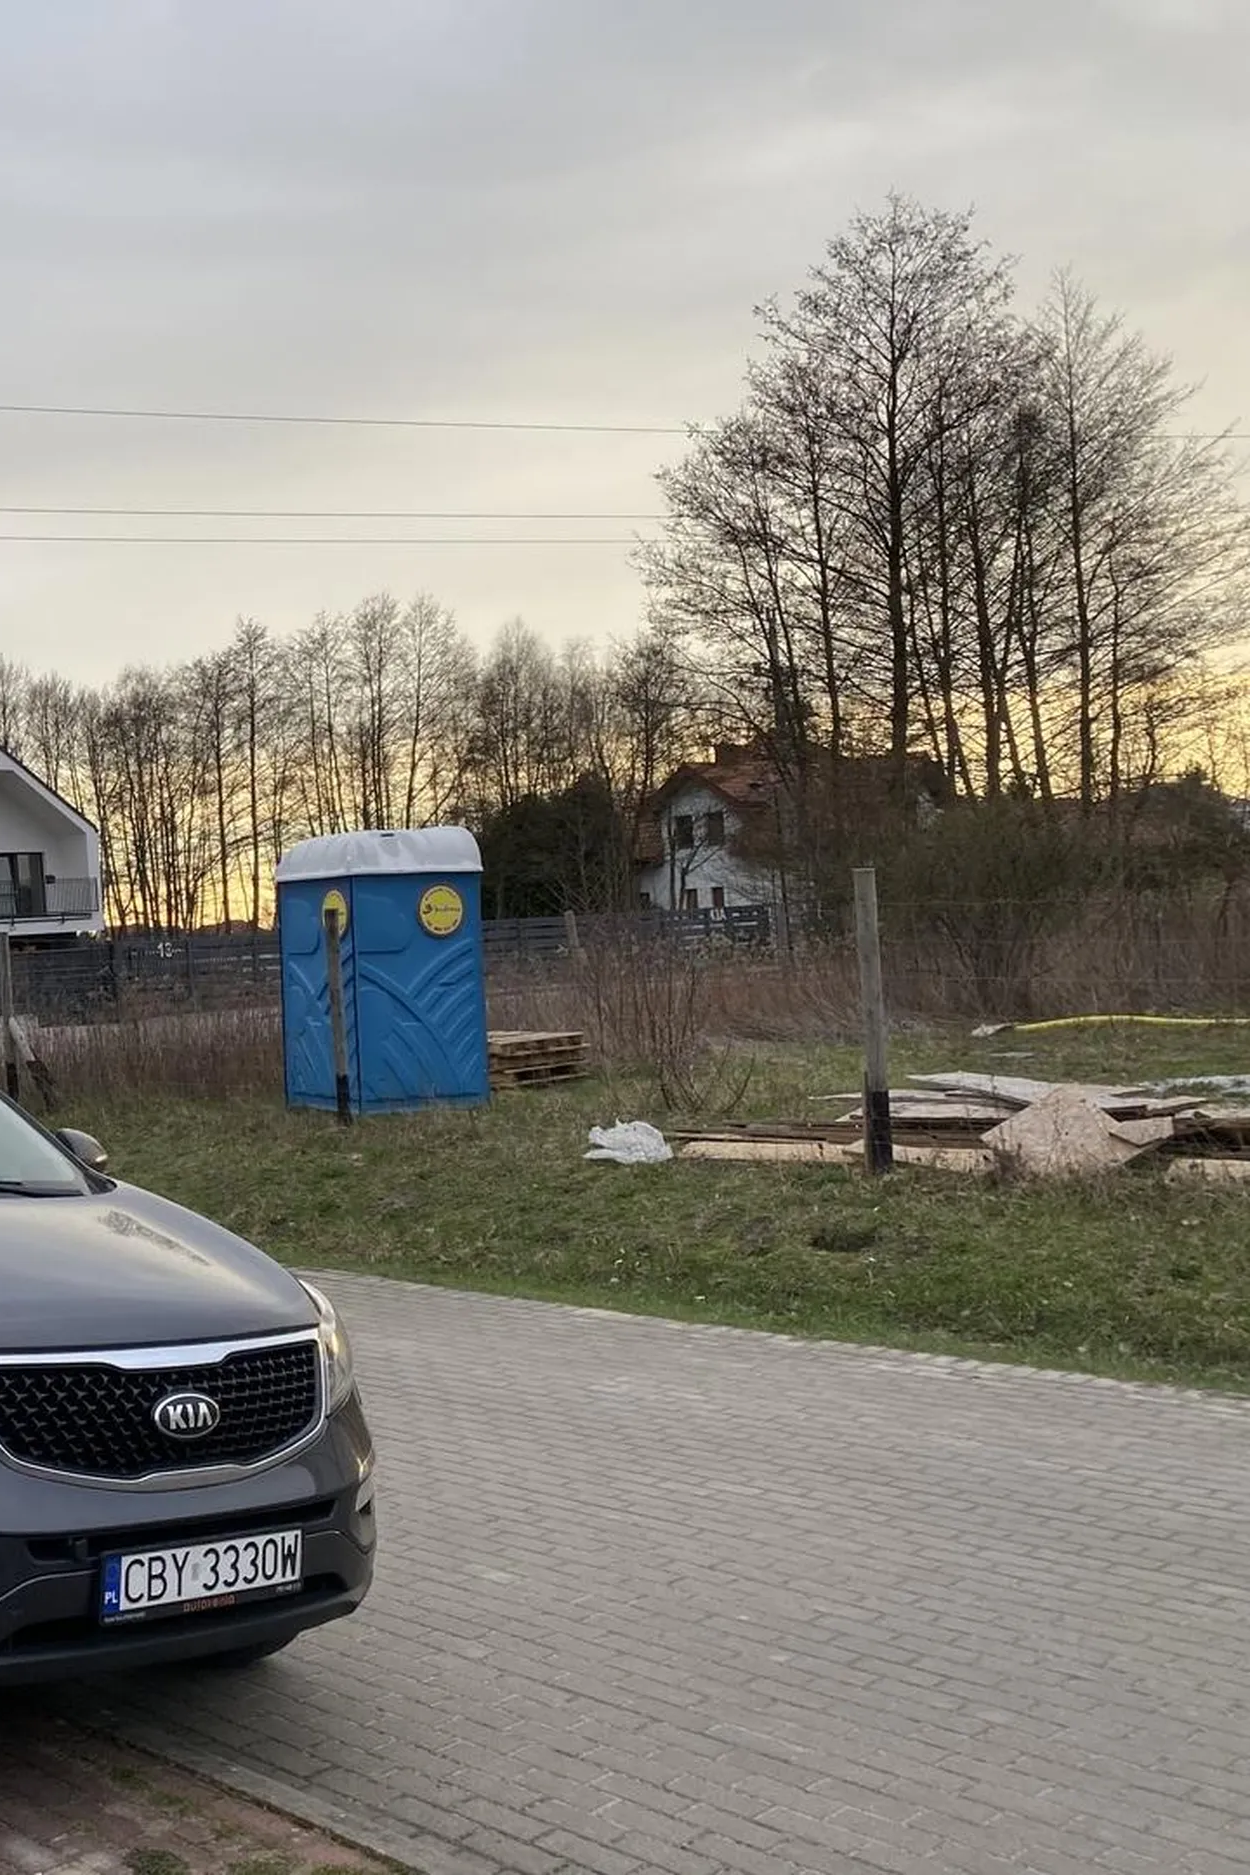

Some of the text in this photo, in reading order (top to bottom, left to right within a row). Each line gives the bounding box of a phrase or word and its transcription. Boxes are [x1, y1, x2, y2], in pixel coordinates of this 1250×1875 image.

[166, 1402, 212, 1430] KIA
[124, 1533, 299, 1603] CBY 3330W
[104, 1591, 118, 1605] PL
